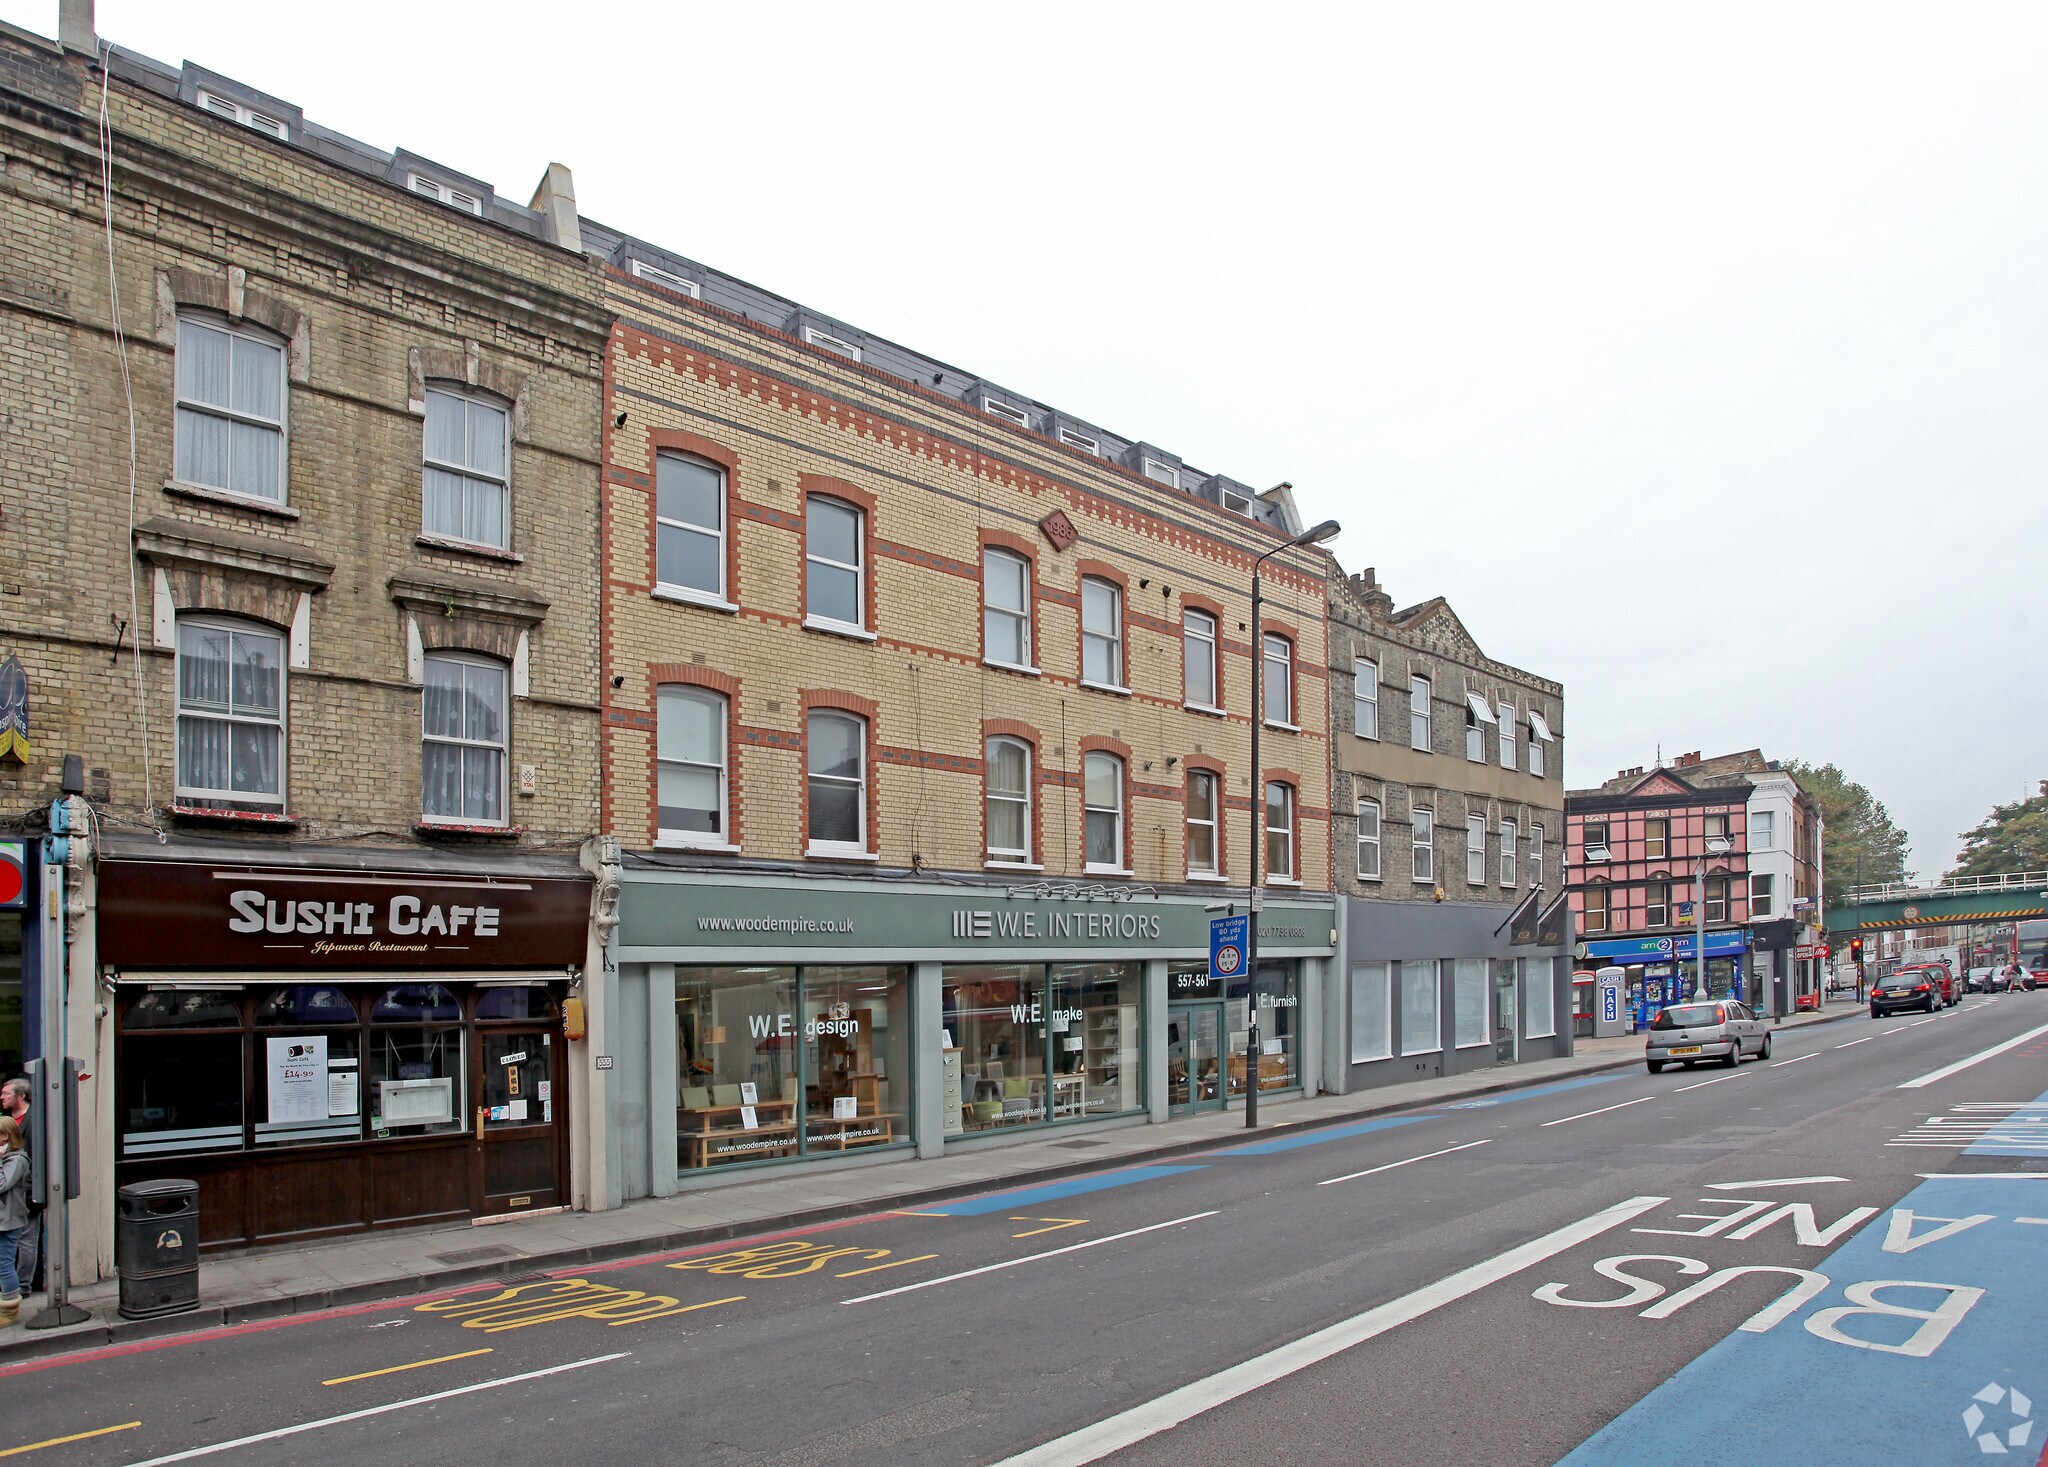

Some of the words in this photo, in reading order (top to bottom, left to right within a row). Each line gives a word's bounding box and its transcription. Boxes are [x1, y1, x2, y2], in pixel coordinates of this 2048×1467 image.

[1048, 521, 1073, 540] 1986
[229, 890, 374, 935] SUSHI
[389, 895, 500, 936] CAFE
[697, 916, 854, 934] www.woodempire.co.uk
[997, 911, 1042, 937] W.E.
[1049, 912, 1160, 939] INTERIORS
[1226, 919, 1246, 927] bridge
[311, 940, 365, 954] Japanese
[367, 941, 429, 953] Restaurant
[1219, 934, 1238, 942] ahead
[1177, 974, 1209, 987] 557-561
[1606, 988, 1614, 1019] CASH
[1010, 1003, 1045, 1024] W.E.
[1052, 1006, 1083, 1020] make
[749, 1014, 797, 1038] W.E.
[805, 1017, 859, 1038] design
[501, 1053, 526, 1063] CLOSED
[284, 1069, 314, 1079] £14.99
[400, 1065, 431, 1074] OPEN
[991, 1106, 1047, 1119] www.woodempire.co.uk
[807, 1127, 880, 1142] www.woodempire.co.uk
[717, 1136, 798, 1153] www.woodempire.co.uk
[1631, 1198, 2048, 1253] ANE
[665, 1241, 892, 1279] BUS
[413, 1278, 680, 1333] STOP
[1532, 1254, 1987, 1357] BUS
